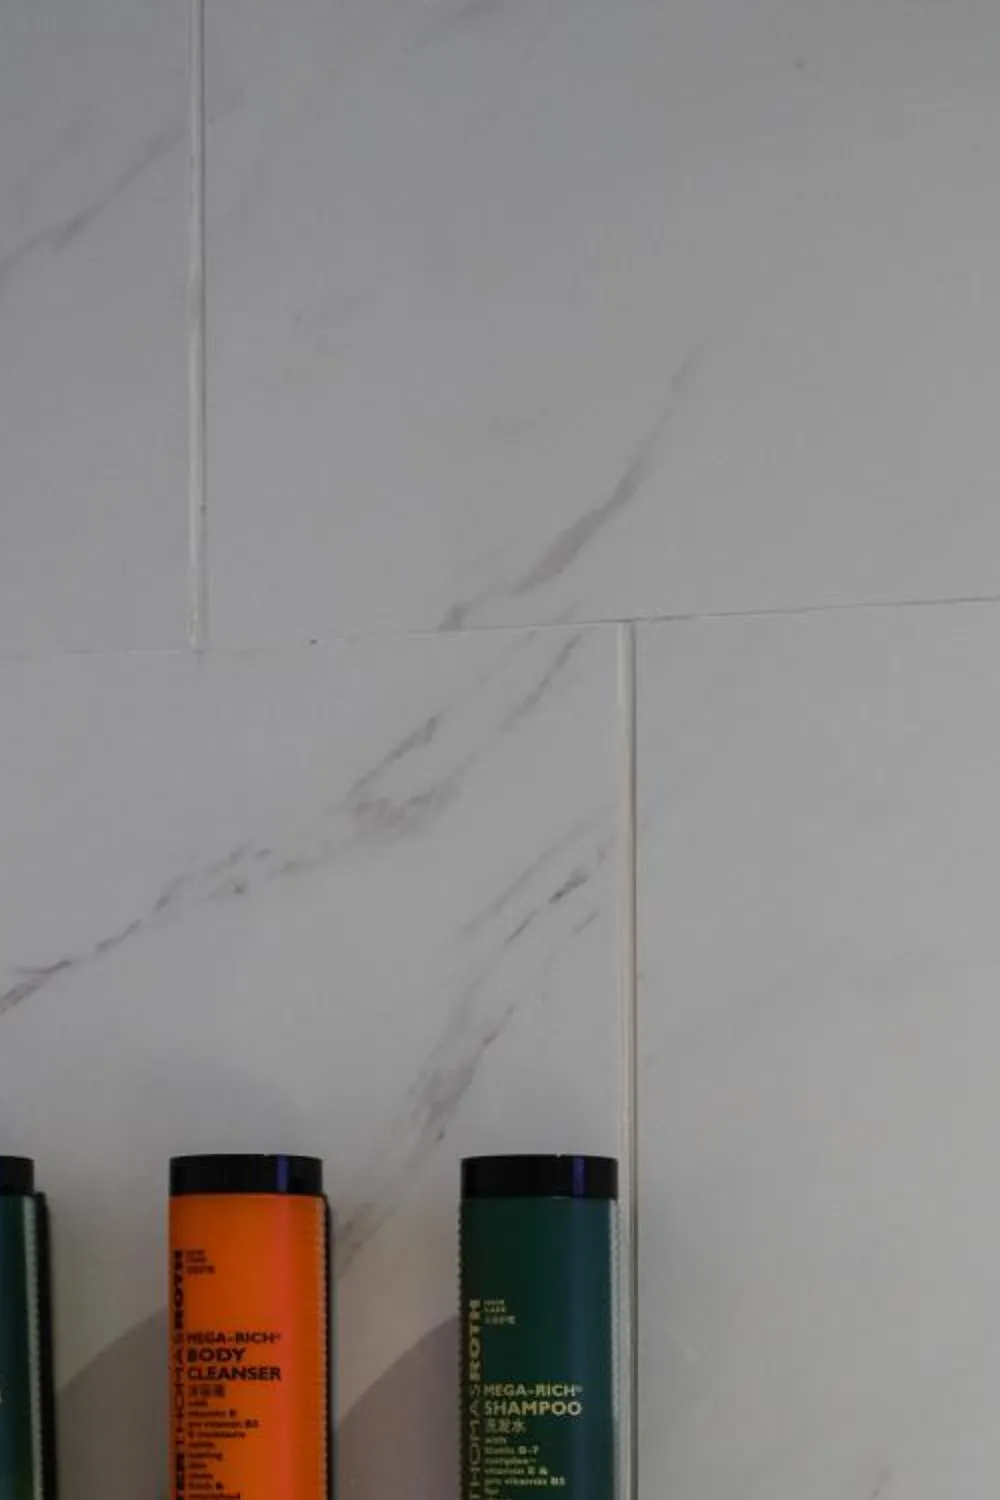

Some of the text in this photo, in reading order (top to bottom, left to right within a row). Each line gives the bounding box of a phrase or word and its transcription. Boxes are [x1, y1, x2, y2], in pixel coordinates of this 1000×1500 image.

[187, 1347, 247, 1362] BODY
[187, 1366, 282, 1381] CLEANSER
[484, 1400, 582, 1416] SHAMPOO
